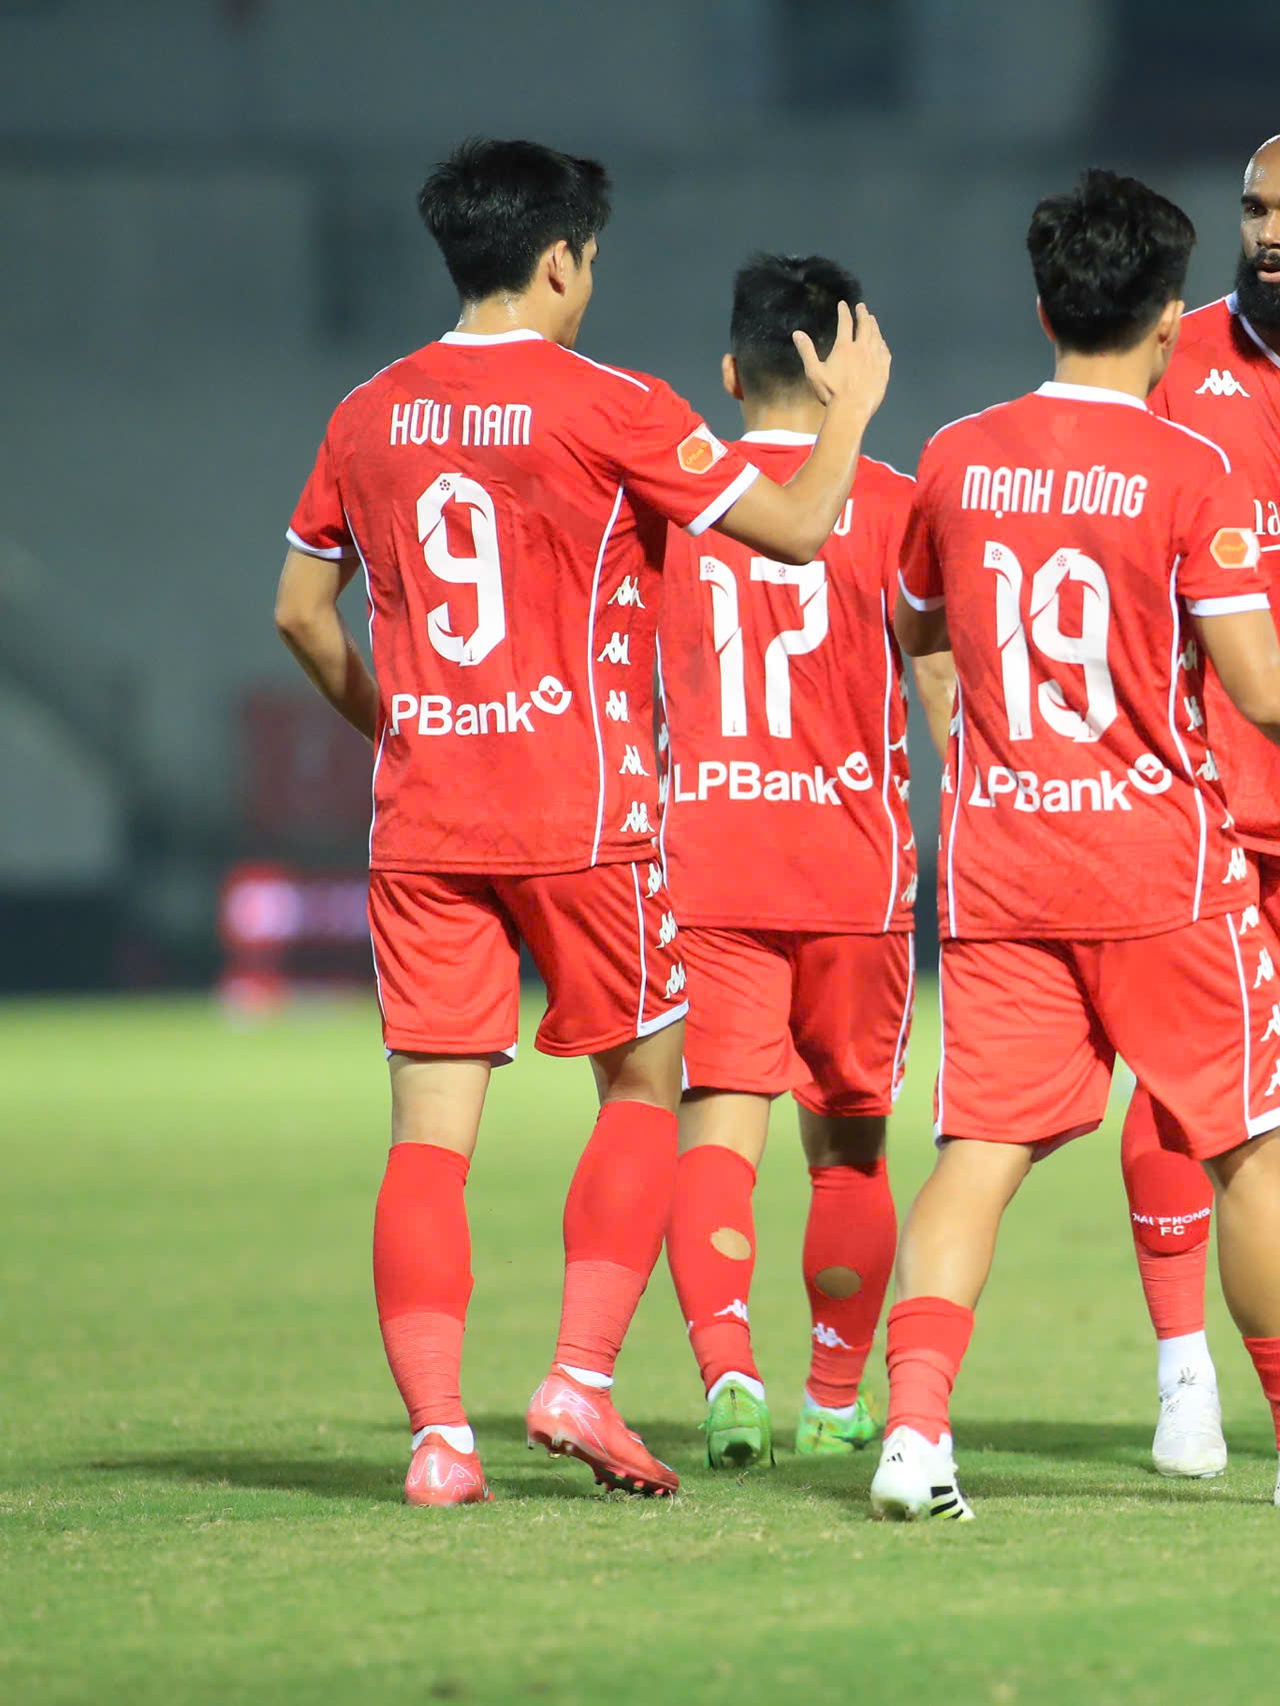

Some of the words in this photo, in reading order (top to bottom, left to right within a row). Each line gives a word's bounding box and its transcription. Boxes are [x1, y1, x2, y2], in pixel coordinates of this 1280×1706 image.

[390, 398, 452, 446] HỮU
[461, 403, 534, 447] NAM
[961, 464, 1055, 519] MẠNH
[1061, 464, 1149, 518] DŨNG
[416, 472, 507, 667] 9
[699, 555, 829, 739] 17
[982, 540, 1119, 744] 19
[388, 691, 536, 736] PBank
[673, 760, 843, 806] LPBank
[967, 765, 1133, 812] LPBank
[1160, 1225, 1185, 1236] FC
